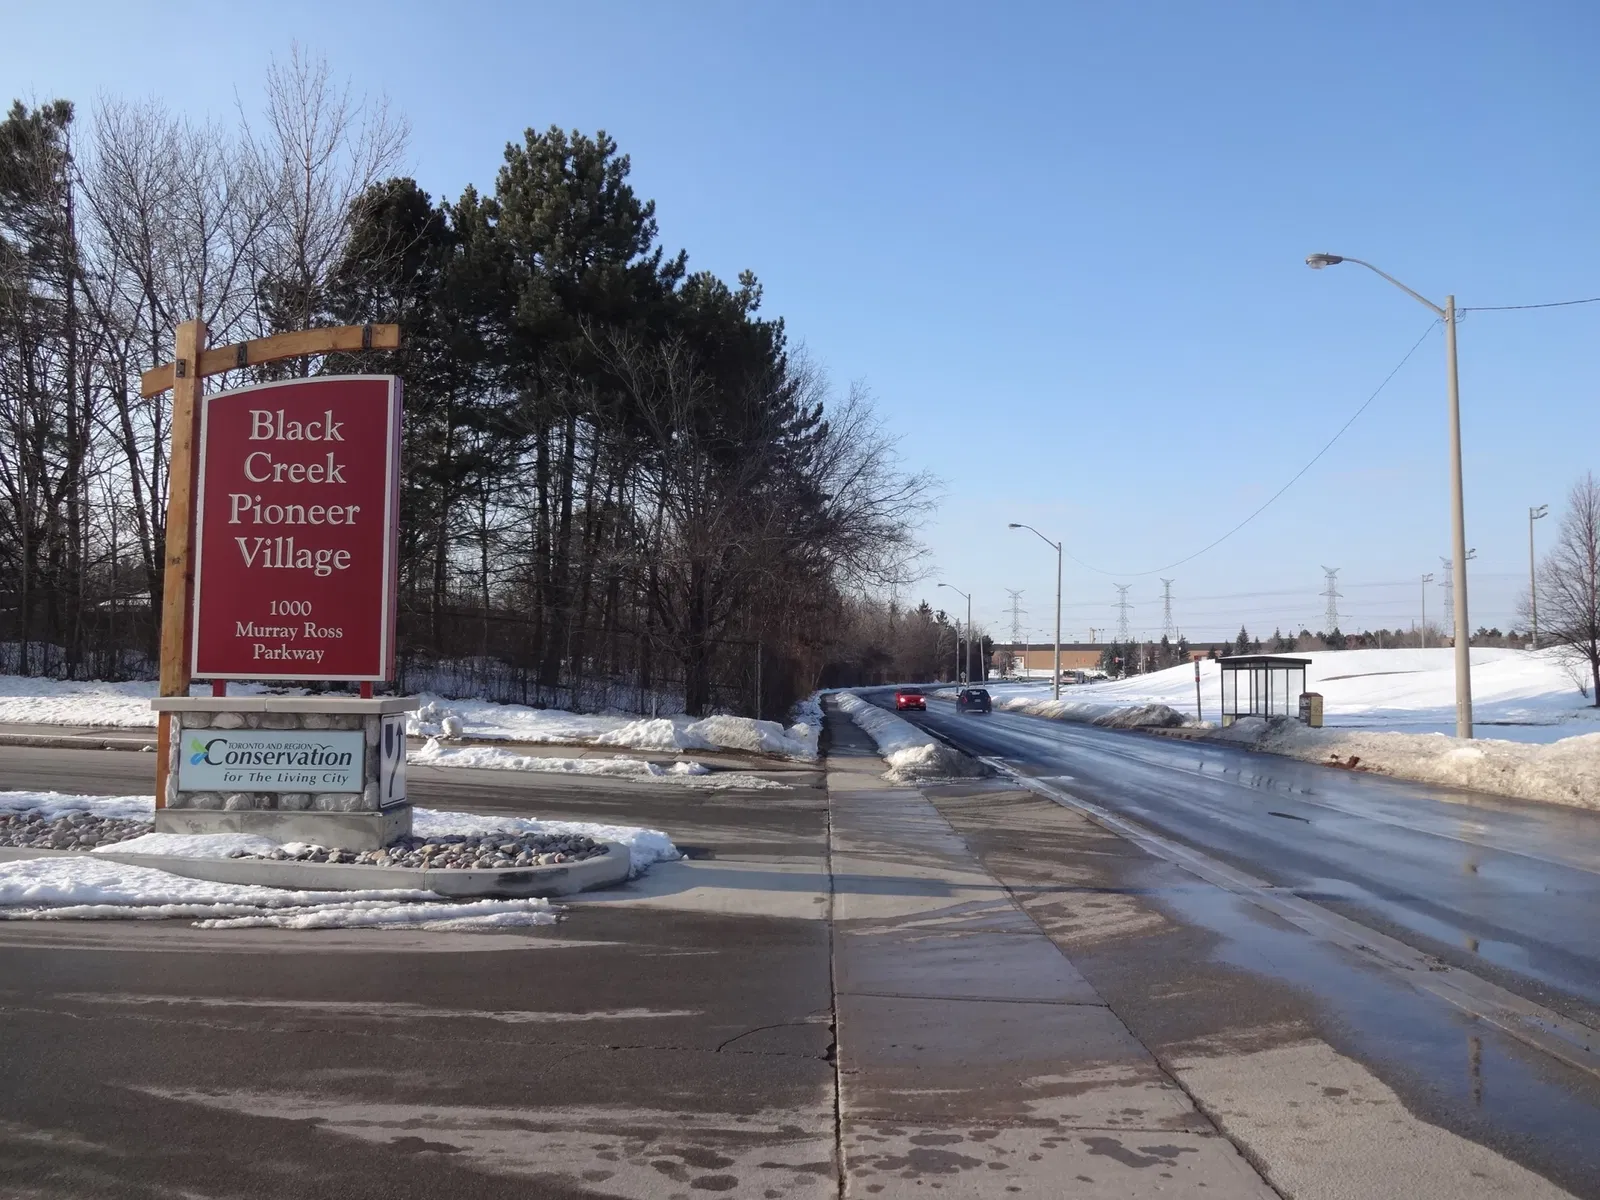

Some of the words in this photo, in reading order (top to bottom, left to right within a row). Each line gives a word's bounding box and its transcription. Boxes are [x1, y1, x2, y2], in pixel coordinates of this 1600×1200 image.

[249, 409, 345, 441] Black
[243, 452, 347, 484] Creek
[228, 494, 360, 525] Pioneer
[234, 536, 351, 577] Village
[269, 600, 312, 616] 1000
[235, 622, 298, 642] Murray
[303, 622, 343, 639] Ross
[253, 643, 325, 664] Parkway
[204, 738, 352, 766] Conservation
[228, 742, 264, 750] TORONTO
[283, 743, 313, 751] REGION
[223, 772, 243, 783] for
[249, 772, 272, 783] The
[277, 773, 317, 785] Living
[322, 773, 349, 785] City
